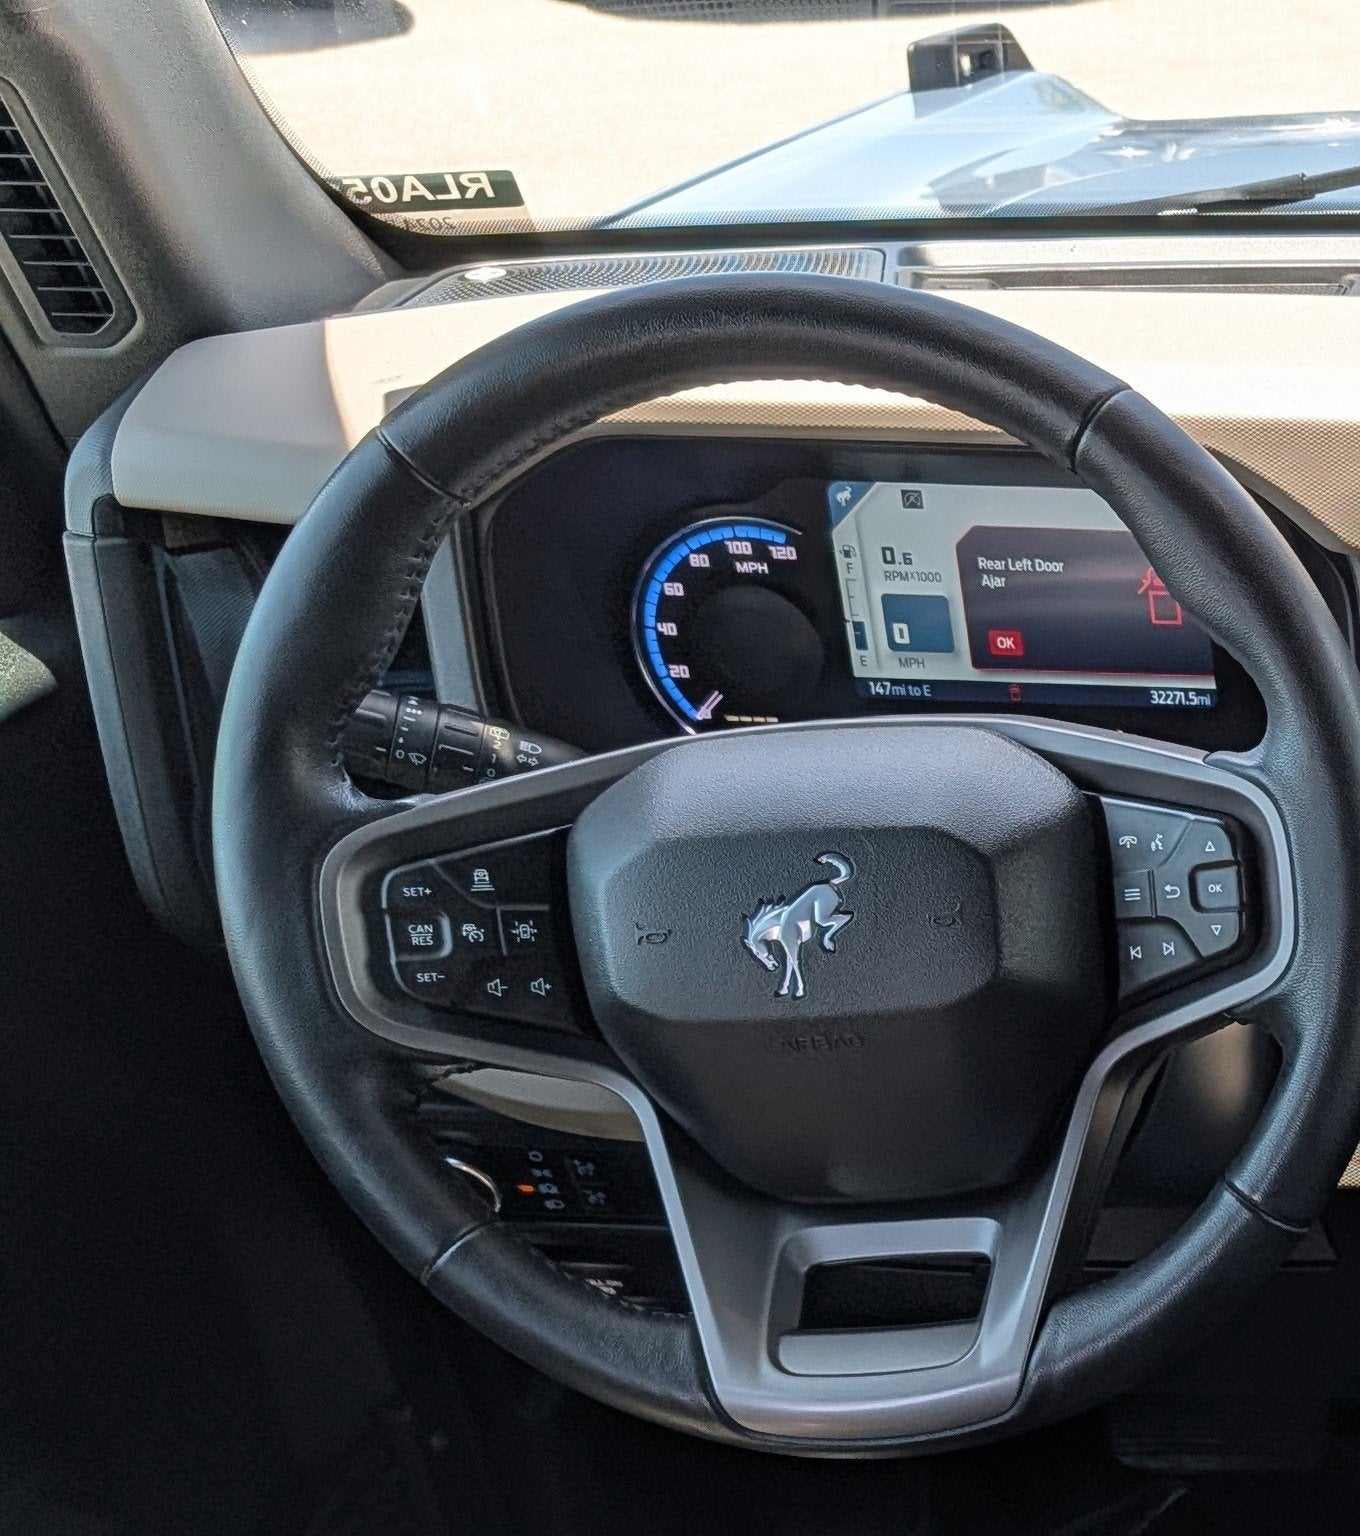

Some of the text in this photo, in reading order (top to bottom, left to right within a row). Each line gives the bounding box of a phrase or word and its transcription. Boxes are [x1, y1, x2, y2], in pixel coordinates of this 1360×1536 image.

[724, 541, 752, 556] 100
[767, 545, 797, 560] 120
[881, 546, 913, 565] 0.6
[689, 553, 710, 568] 80
[735, 561, 769, 574] MPH
[977, 556, 1064, 574] Rear Left Door
[846, 563, 853, 574] F
[981, 573, 1006, 590] Ajar
[663, 582, 684, 597] 60
[656, 621, 678, 637] 40
[892, 622, 911, 644] 0
[996, 635, 1016, 651] OK
[859, 655, 868, 667] E
[898, 657, 926, 669] MPH
[669, 664, 690, 679] 20
[908, 684, 921, 697] to
[922, 685, 931, 697] E
[1208, 884, 1223, 894] OK
[408, 924, 433, 934] CAN
[411, 935, 434, 946] RES
